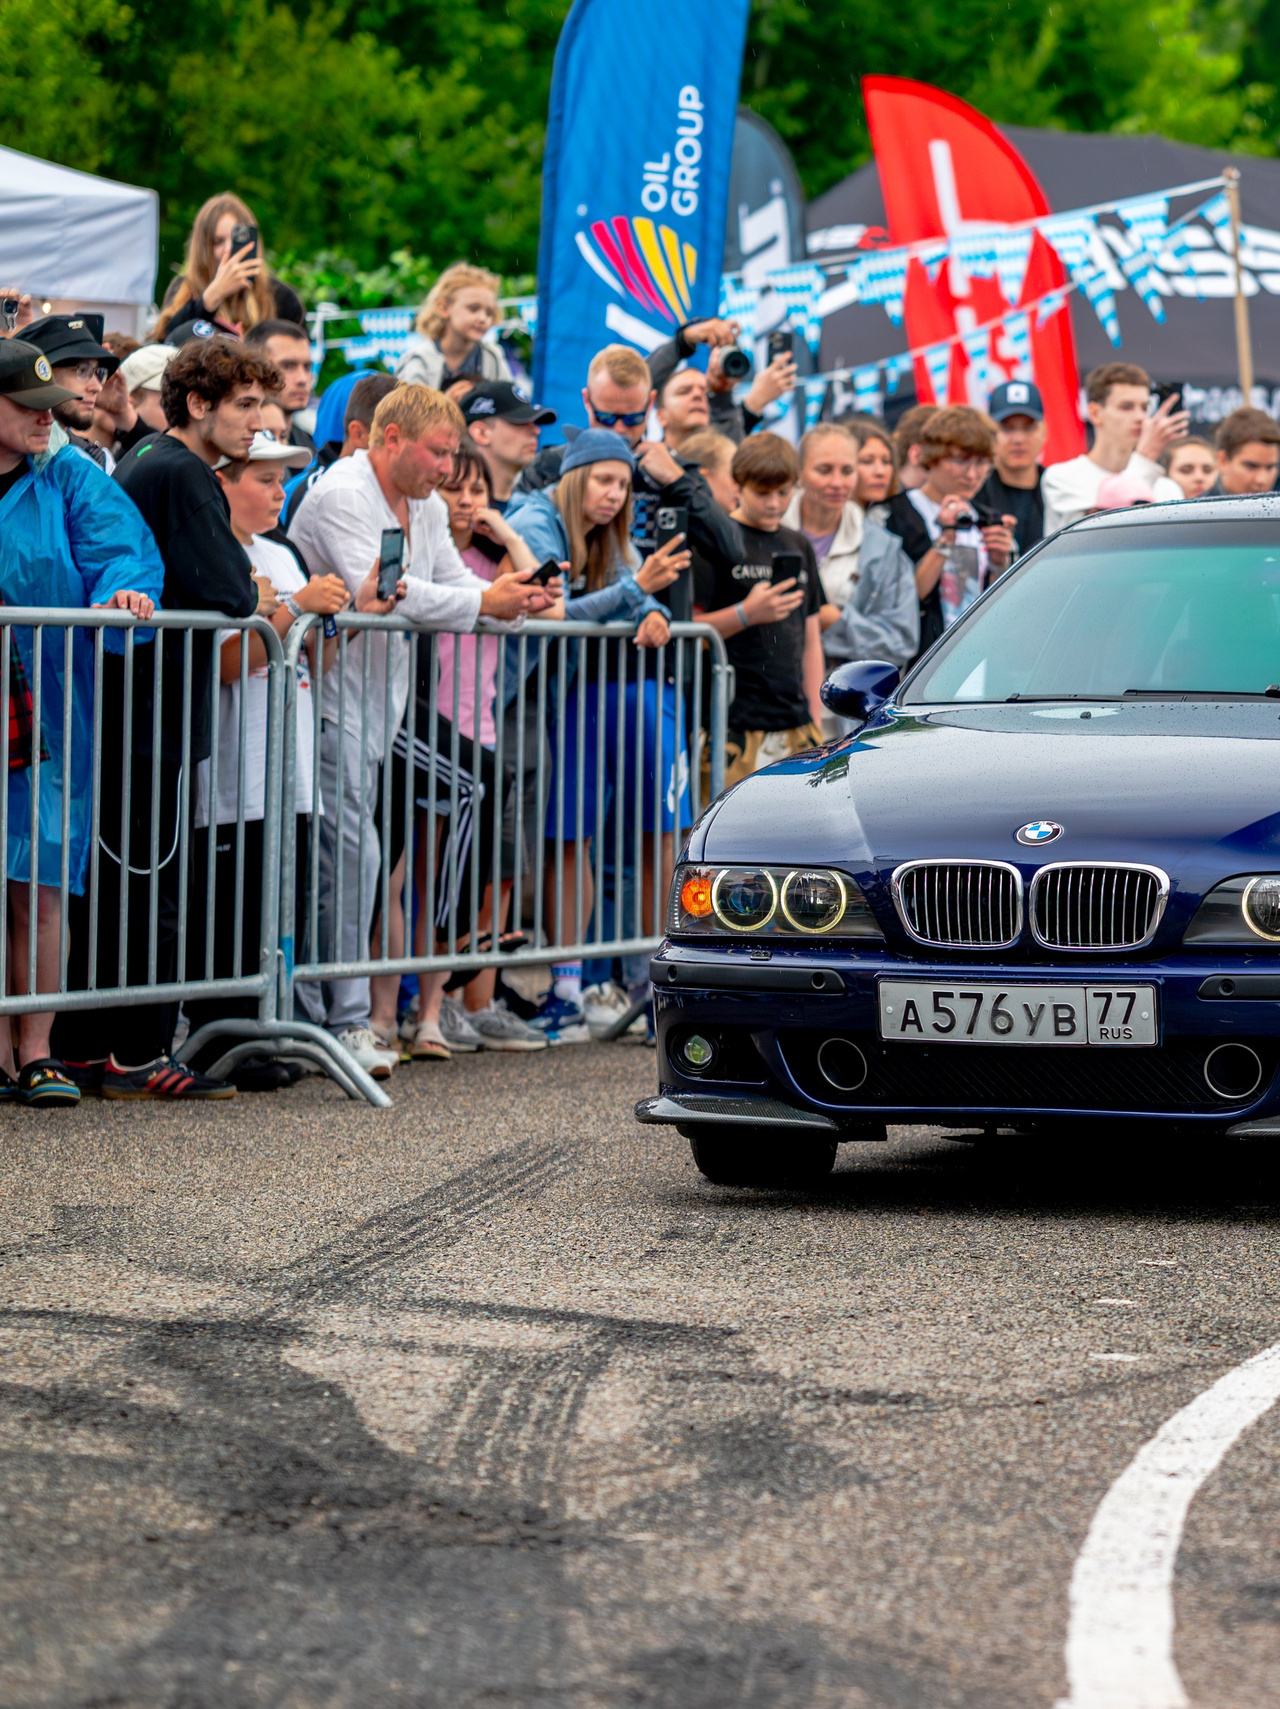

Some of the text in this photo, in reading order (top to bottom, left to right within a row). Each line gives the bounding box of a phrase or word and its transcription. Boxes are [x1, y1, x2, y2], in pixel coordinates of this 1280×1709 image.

[671, 85, 704, 216] GROUP
[641, 152, 670, 212] OIL
[900, 991, 1077, 1036] А576УВ
[1093, 992, 1137, 1025] 77
[1100, 1027, 1133, 1040] RUS
